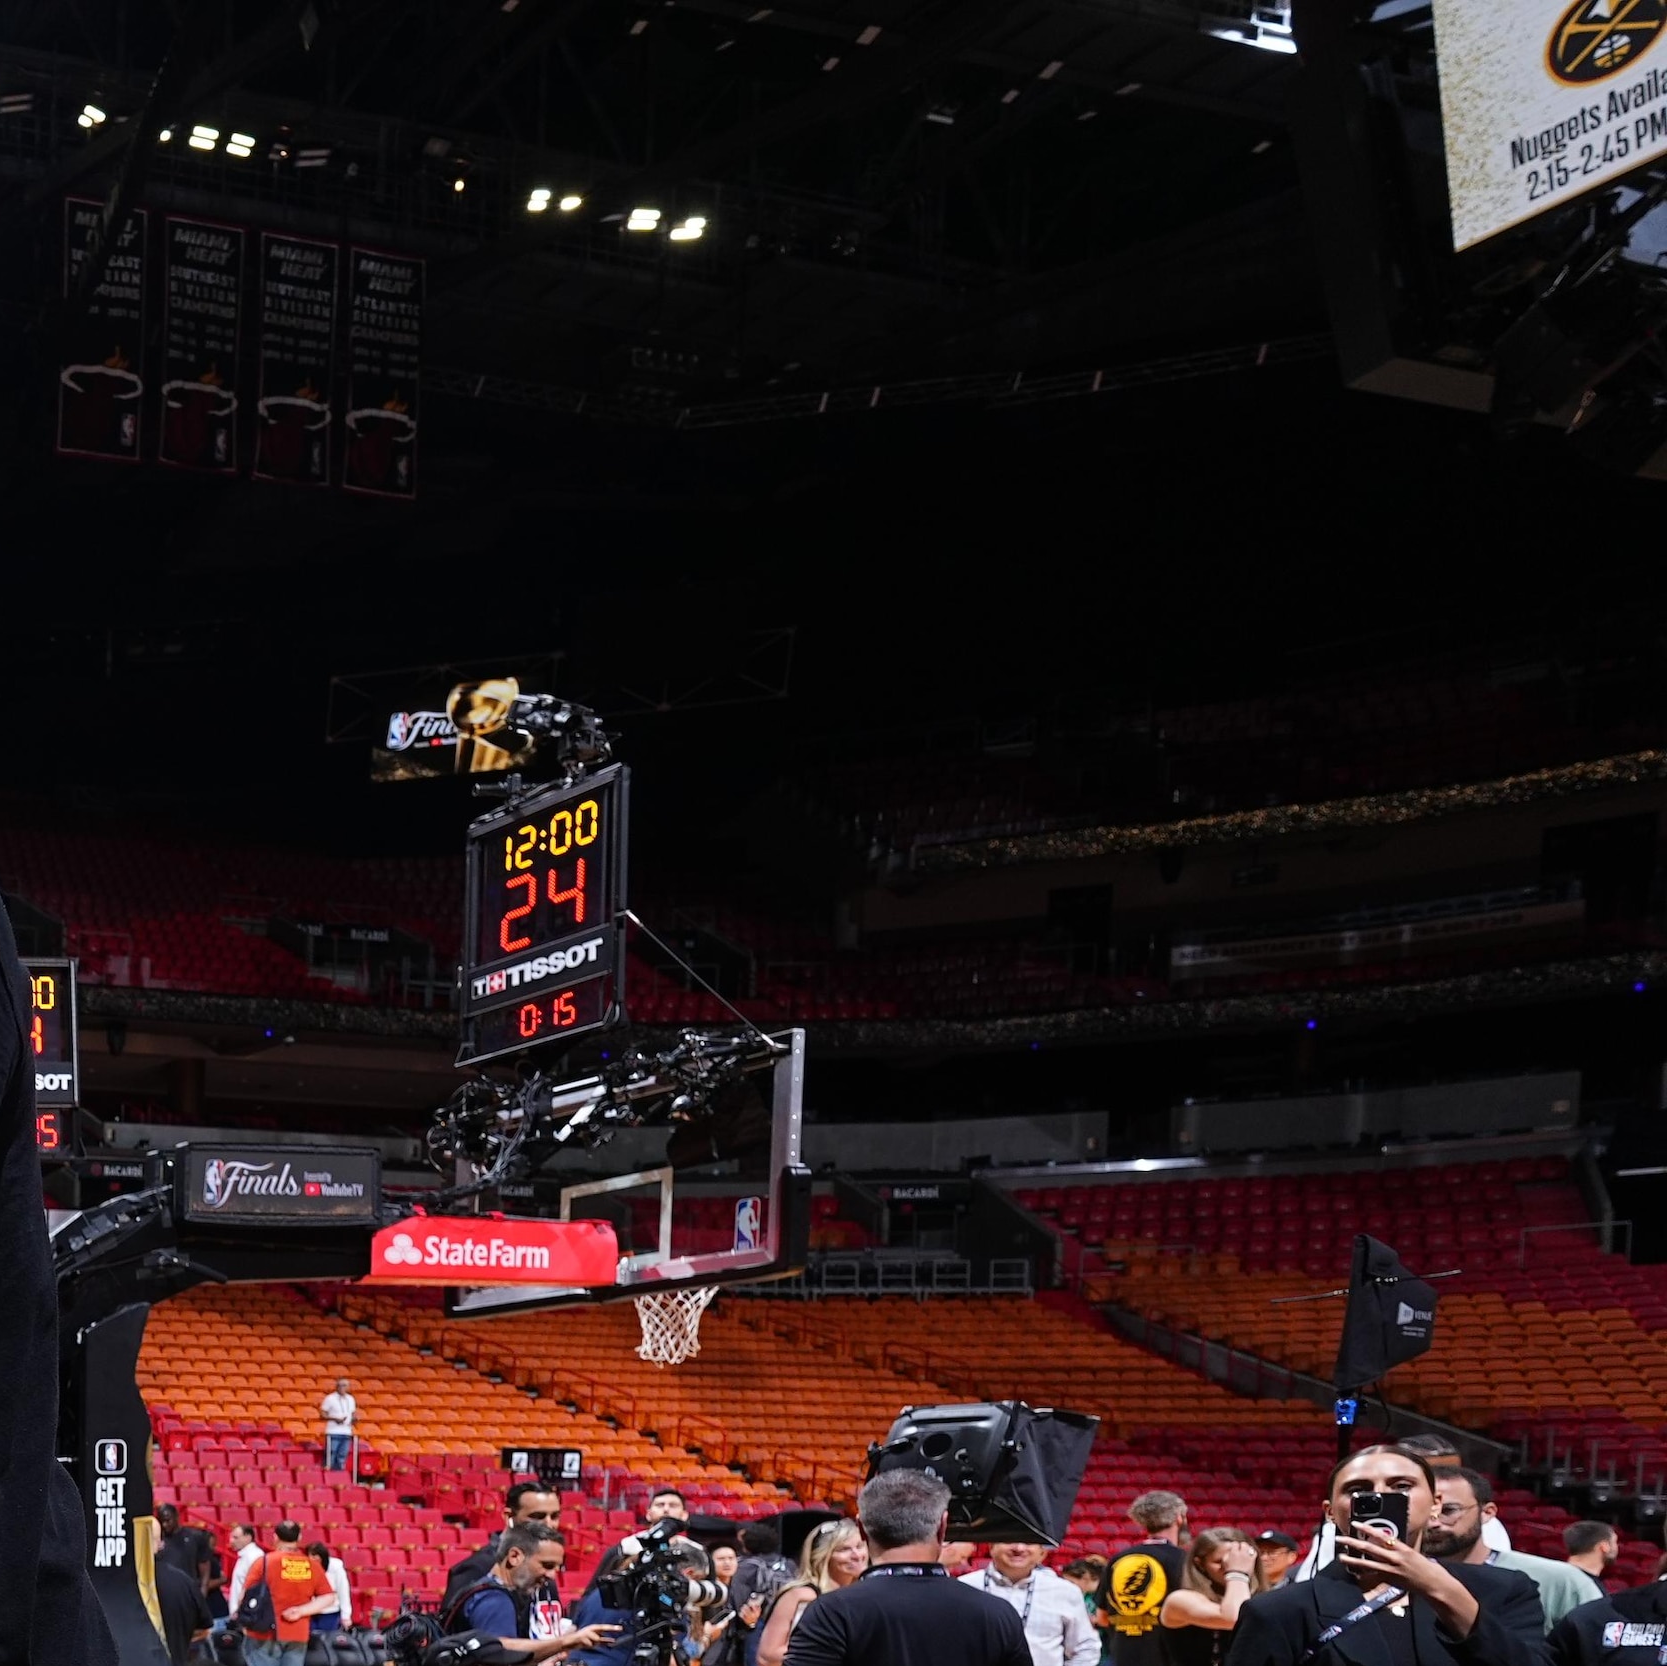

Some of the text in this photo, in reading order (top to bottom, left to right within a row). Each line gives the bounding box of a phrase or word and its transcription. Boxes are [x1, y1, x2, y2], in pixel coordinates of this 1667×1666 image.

[1510, 104, 1602, 169] Nuggets
[185, 246, 235, 266] HEAT
[505, 799, 599, 871] 12:00
[500, 857, 586, 953] 24
[506, 937, 604, 988] TISSOT
[520, 991, 576, 1039] 0:15
[214, 1160, 301, 1208] Finals
[95, 1477, 126, 1507] GET
[95, 1507, 126, 1537] THE
[94, 1537, 126, 1567] APP
